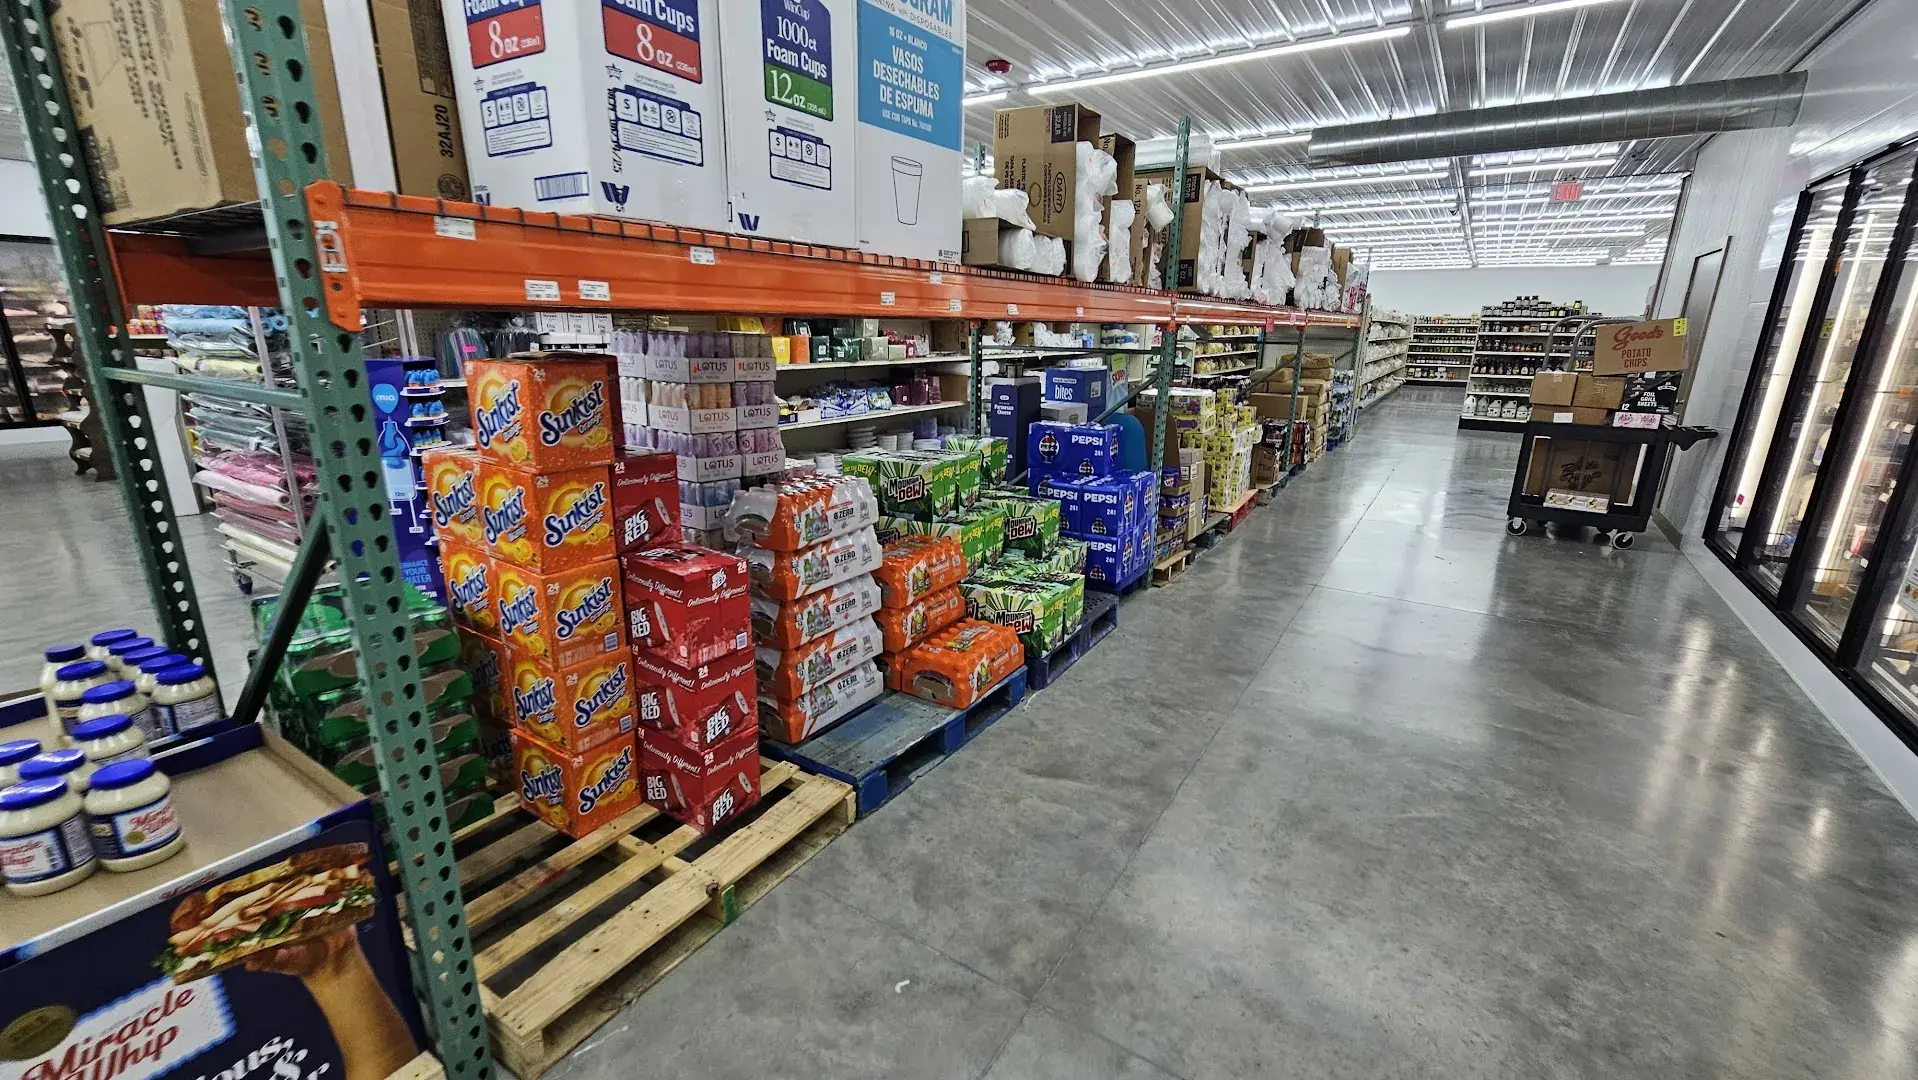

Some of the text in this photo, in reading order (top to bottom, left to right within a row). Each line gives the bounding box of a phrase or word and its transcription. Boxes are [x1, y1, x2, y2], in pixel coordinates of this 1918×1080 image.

[910, 12, 953, 40] DISPOSABLES
[767, 38, 827, 79] Foam Cups
[892, 45, 924, 74] VASOS
[873, 59, 940, 101] DESECHABLES
[880, 84, 934, 119] DE ESPUMA
[433, 104, 455, 159] 32AJ20
[1055, 177, 1064, 208] DART
[1135, 184, 1143, 197] No.
[1554, 184, 1579, 201] EXIT
[1621, 347, 1652, 359] POTATO
[697, 361, 728, 373] LOTUS
[742, 361, 771, 372] LOTUS
[1624, 357, 1648, 368] CHIPS
[1054, 384, 1073, 401] bites
[476, 379, 524, 450] Sunkist
[538, 379, 606, 447] Sunkist
[743, 407, 772, 418] LOTUS
[1621, 403, 1630, 411] 12
[699, 412, 730, 423] LOTUS
[1071, 435, 1104, 446] PEPSI
[614, 461, 626, 474] 24
[704, 459, 735, 470] LOTUS
[752, 455, 780, 466] LOTUS
[857, 464, 875, 477] DEW
[433, 470, 478, 529] Sunkist
[1047, 488, 1078, 500] PEPSI
[1084, 492, 1118, 504] PEPSI
[482, 485, 527, 547] Sunkist
[543, 481, 607, 548] Sunkist
[624, 509, 646, 533] BIG
[839, 507, 854, 519] ZERO
[624, 519, 649, 546] RED
[840, 550, 856, 562] ZERO
[403, 566, 427, 576] YOUR
[712, 567, 726, 584] BIG
[737, 561, 748, 575] 24
[711, 573, 728, 592] RED
[555, 576, 613, 641] Sunkist
[841, 598, 856, 612] ZERO
[631, 607, 647, 623] BIG
[631, 620, 650, 639] RED
[842, 644, 858, 657] ZERO
[698, 664, 709, 679] 24
[842, 674, 858, 688] ZERO
[573, 661, 628, 729] Sunkist
[641, 691, 657, 708] BIG
[641, 704, 661, 720] RED
[706, 705, 727, 729] BIG
[706, 714, 730, 744] RED
[703, 751, 715, 766] 24
[577, 744, 633, 817] Sunkist
[646, 775, 664, 789] BIG
[647, 786, 668, 800] RED
[712, 787, 731, 812] BIG
[712, 795, 734, 826] RED
[21, 988, 196, 1080] Miracle
